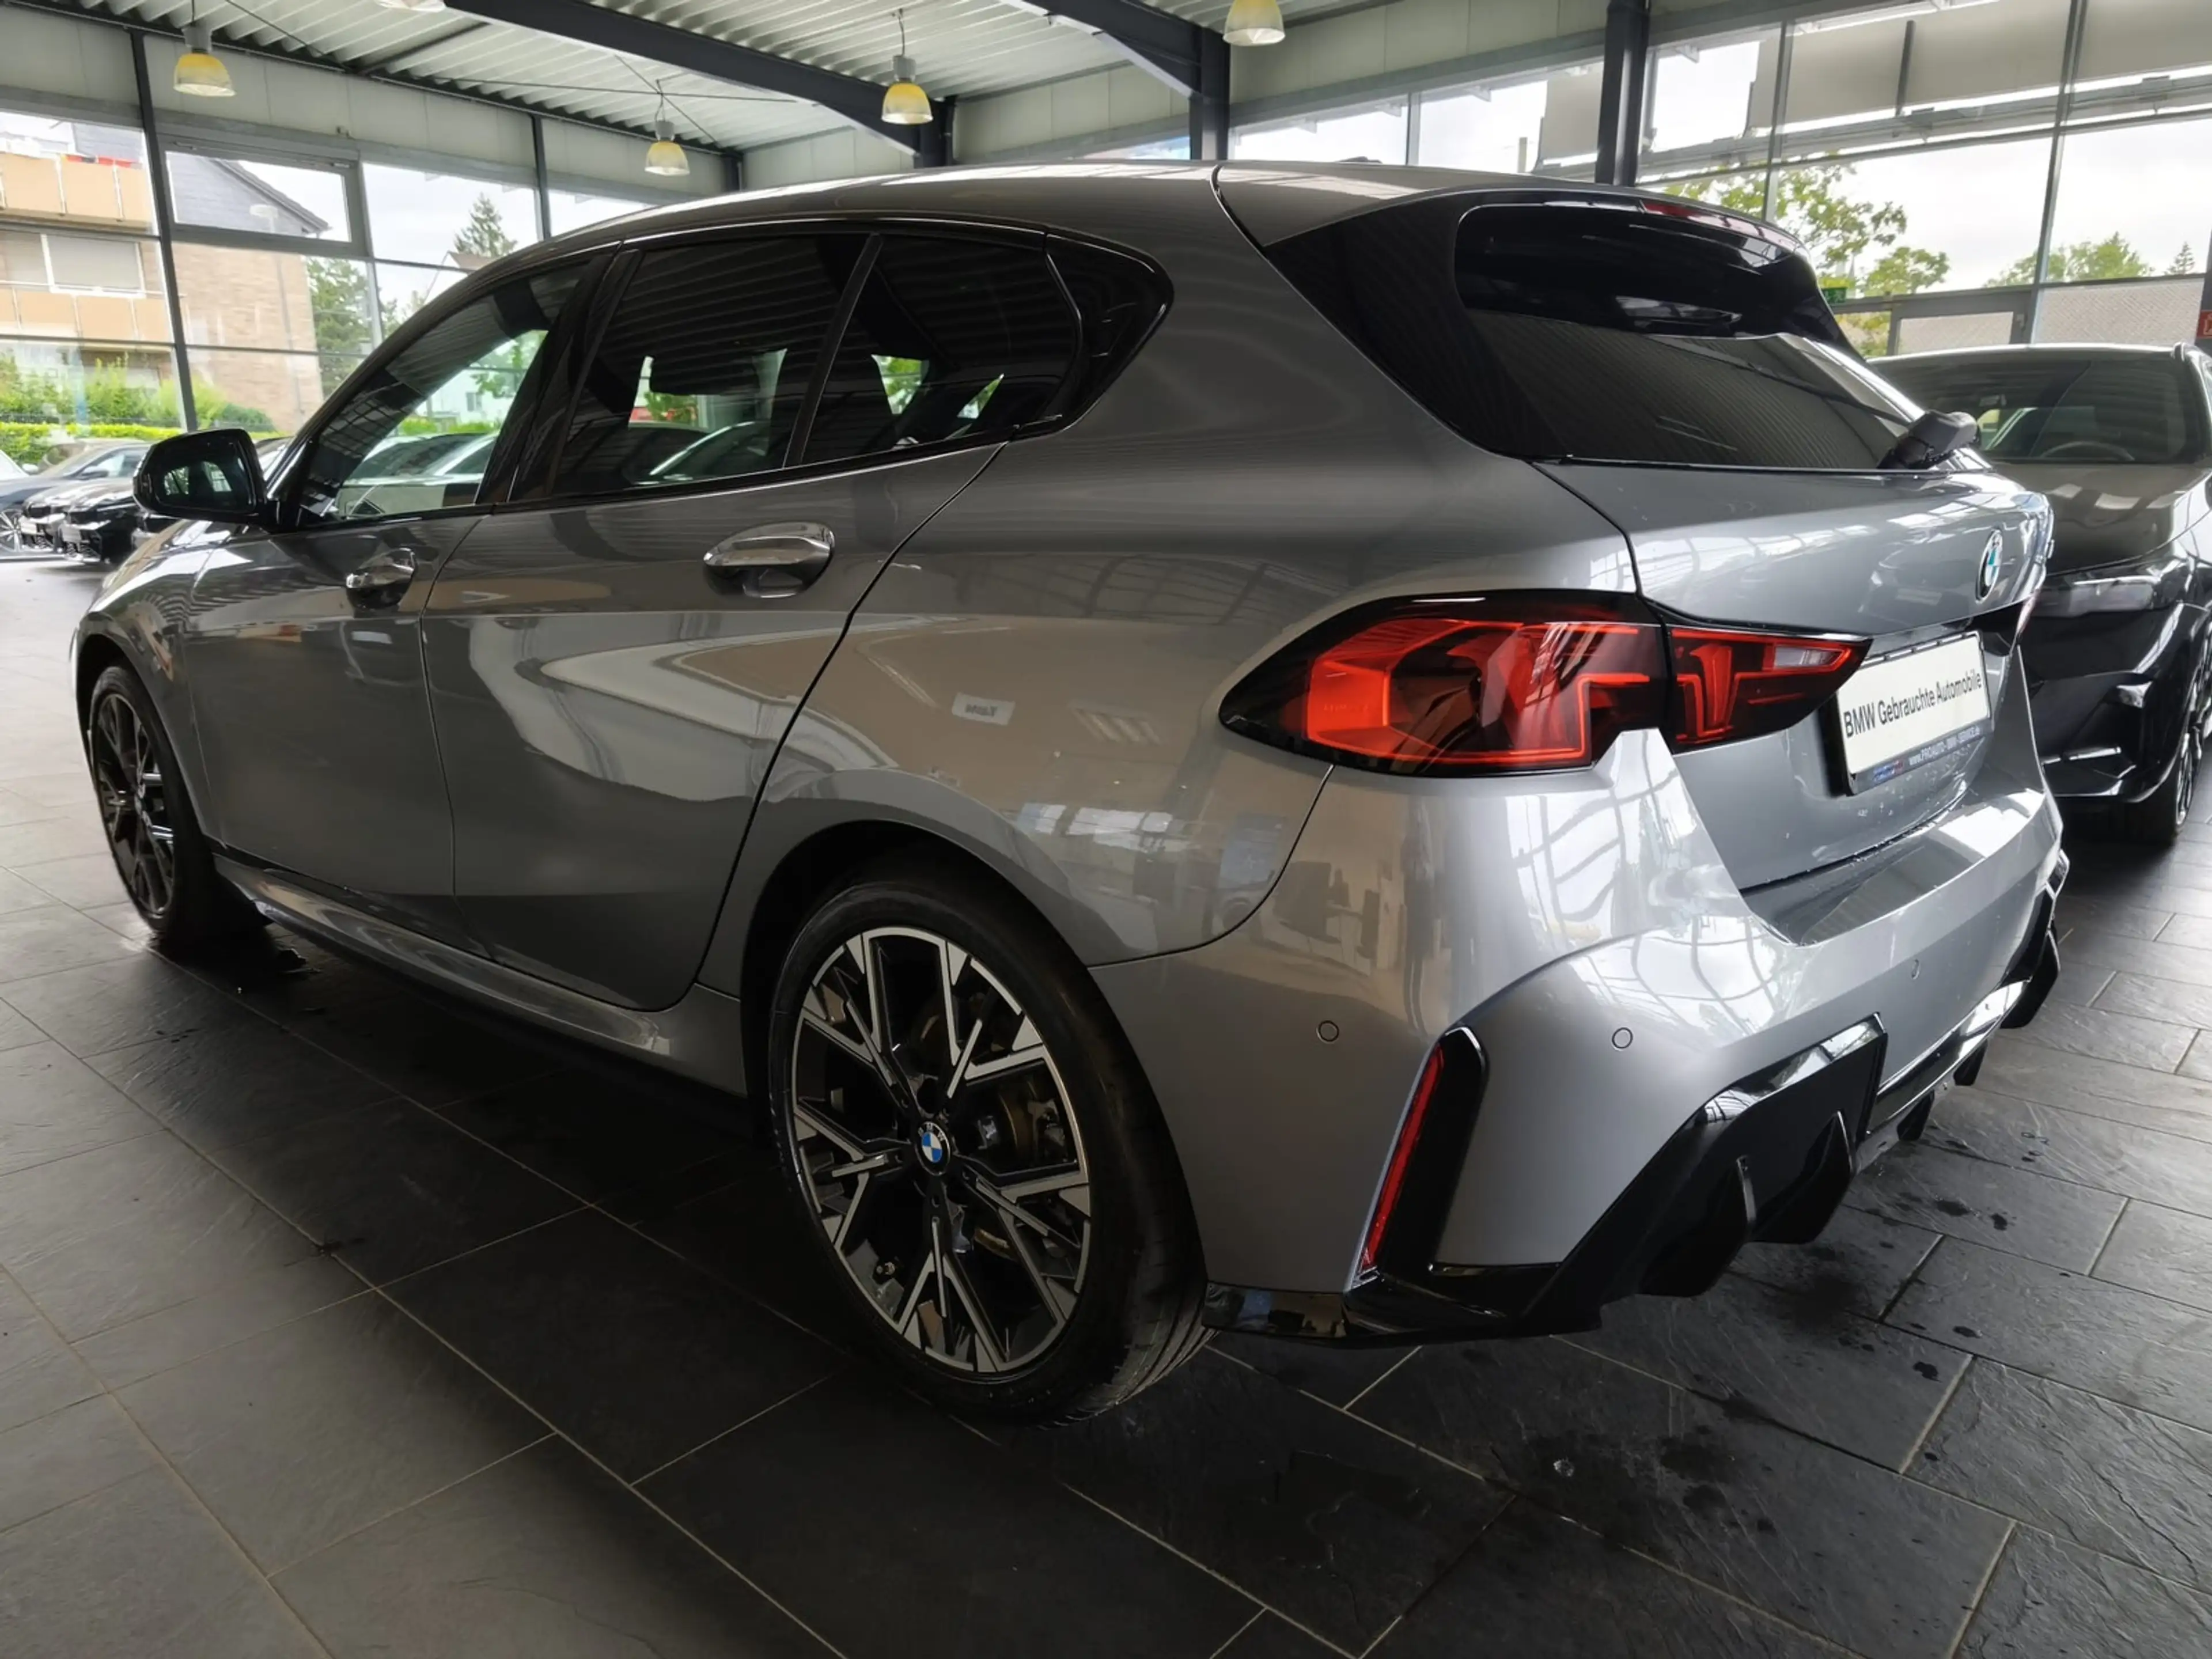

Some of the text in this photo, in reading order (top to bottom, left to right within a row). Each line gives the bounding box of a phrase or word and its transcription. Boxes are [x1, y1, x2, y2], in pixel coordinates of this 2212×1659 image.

[1843, 669, 1982, 738] BMW Gebrauchte Automobile
